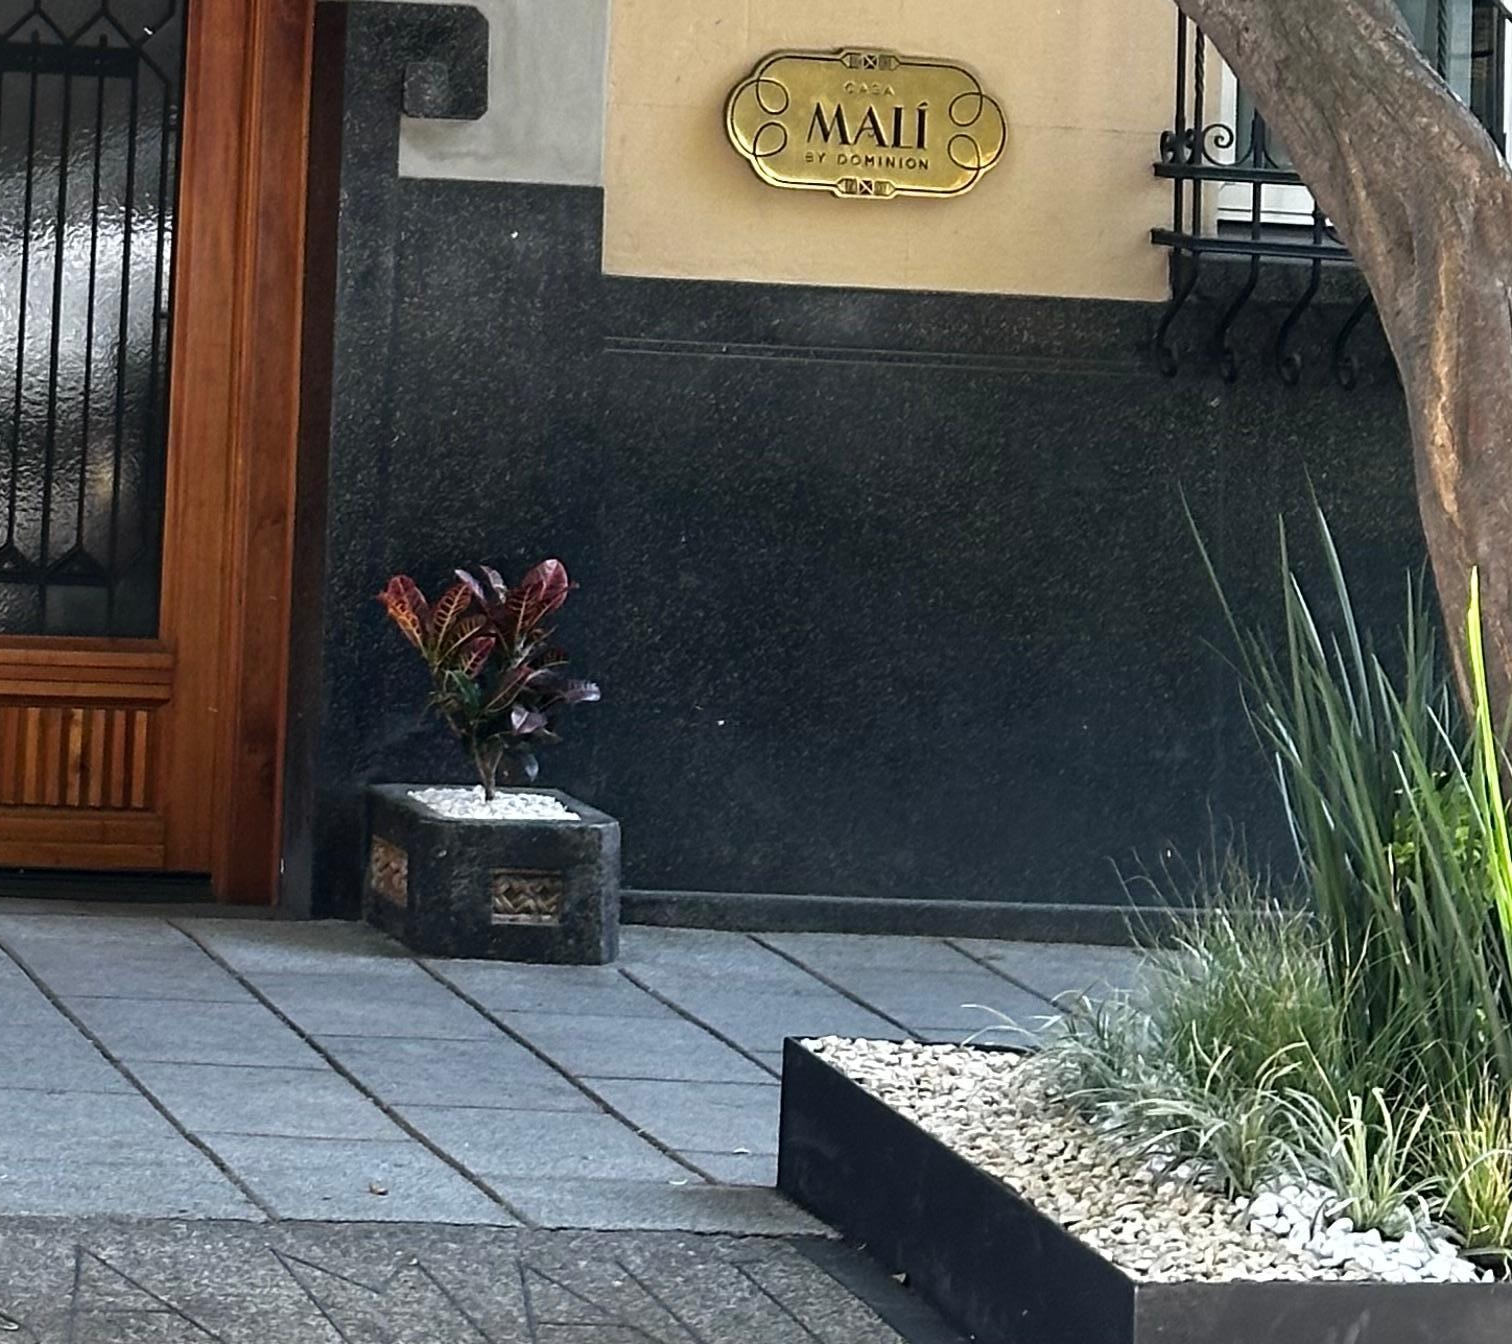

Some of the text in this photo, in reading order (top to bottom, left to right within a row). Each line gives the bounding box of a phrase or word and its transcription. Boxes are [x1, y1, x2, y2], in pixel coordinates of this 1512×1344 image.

[843, 80, 895, 97] CASA
[806, 100, 928, 150] MALÍ
[805, 151, 929, 170] BY DOMINION
